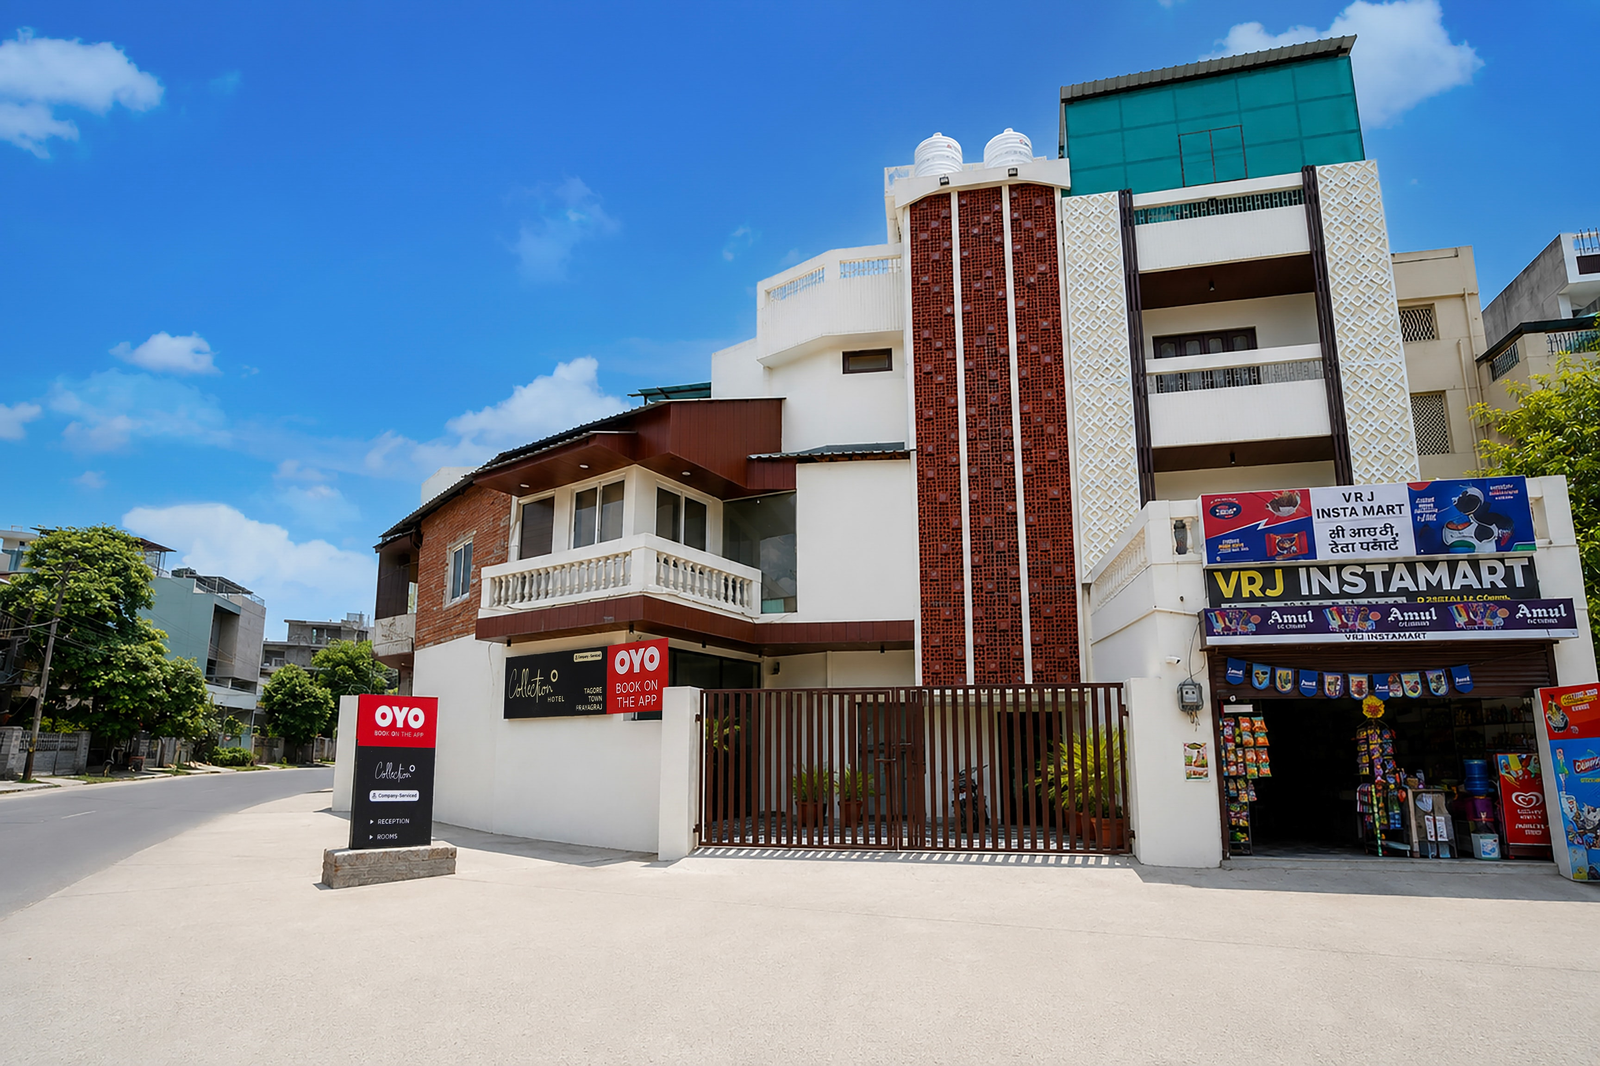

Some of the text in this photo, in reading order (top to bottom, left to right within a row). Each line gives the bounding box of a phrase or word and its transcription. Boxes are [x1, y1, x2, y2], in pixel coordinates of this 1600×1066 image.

[1316, 506, 1358, 519] INSTA
[1362, 503, 1405, 516] MART
[1213, 557, 1530, 598] VRJ INSTAMART
[1268, 610, 1314, 625] Amul
[1387, 606, 1437, 622] Amul
[1515, 603, 1567, 619] Amul
[1367, 632, 1427, 640] INSTAMART
[614, 645, 661, 675] OYO
[508, 668, 554, 703] Collection
[584, 686, 603, 694] TAGORE
[615, 679, 658, 694] BOOK ON
[547, 695, 565, 703] HOTEL
[617, 694, 658, 708] THE APP
[575, 703, 603, 711] PRAYAGRAJ
[374, 704, 425, 729] OYO
[374, 729, 390, 737] BOOK
[374, 761, 411, 783] Collection
[377, 817, 410, 825] RECEPTION
